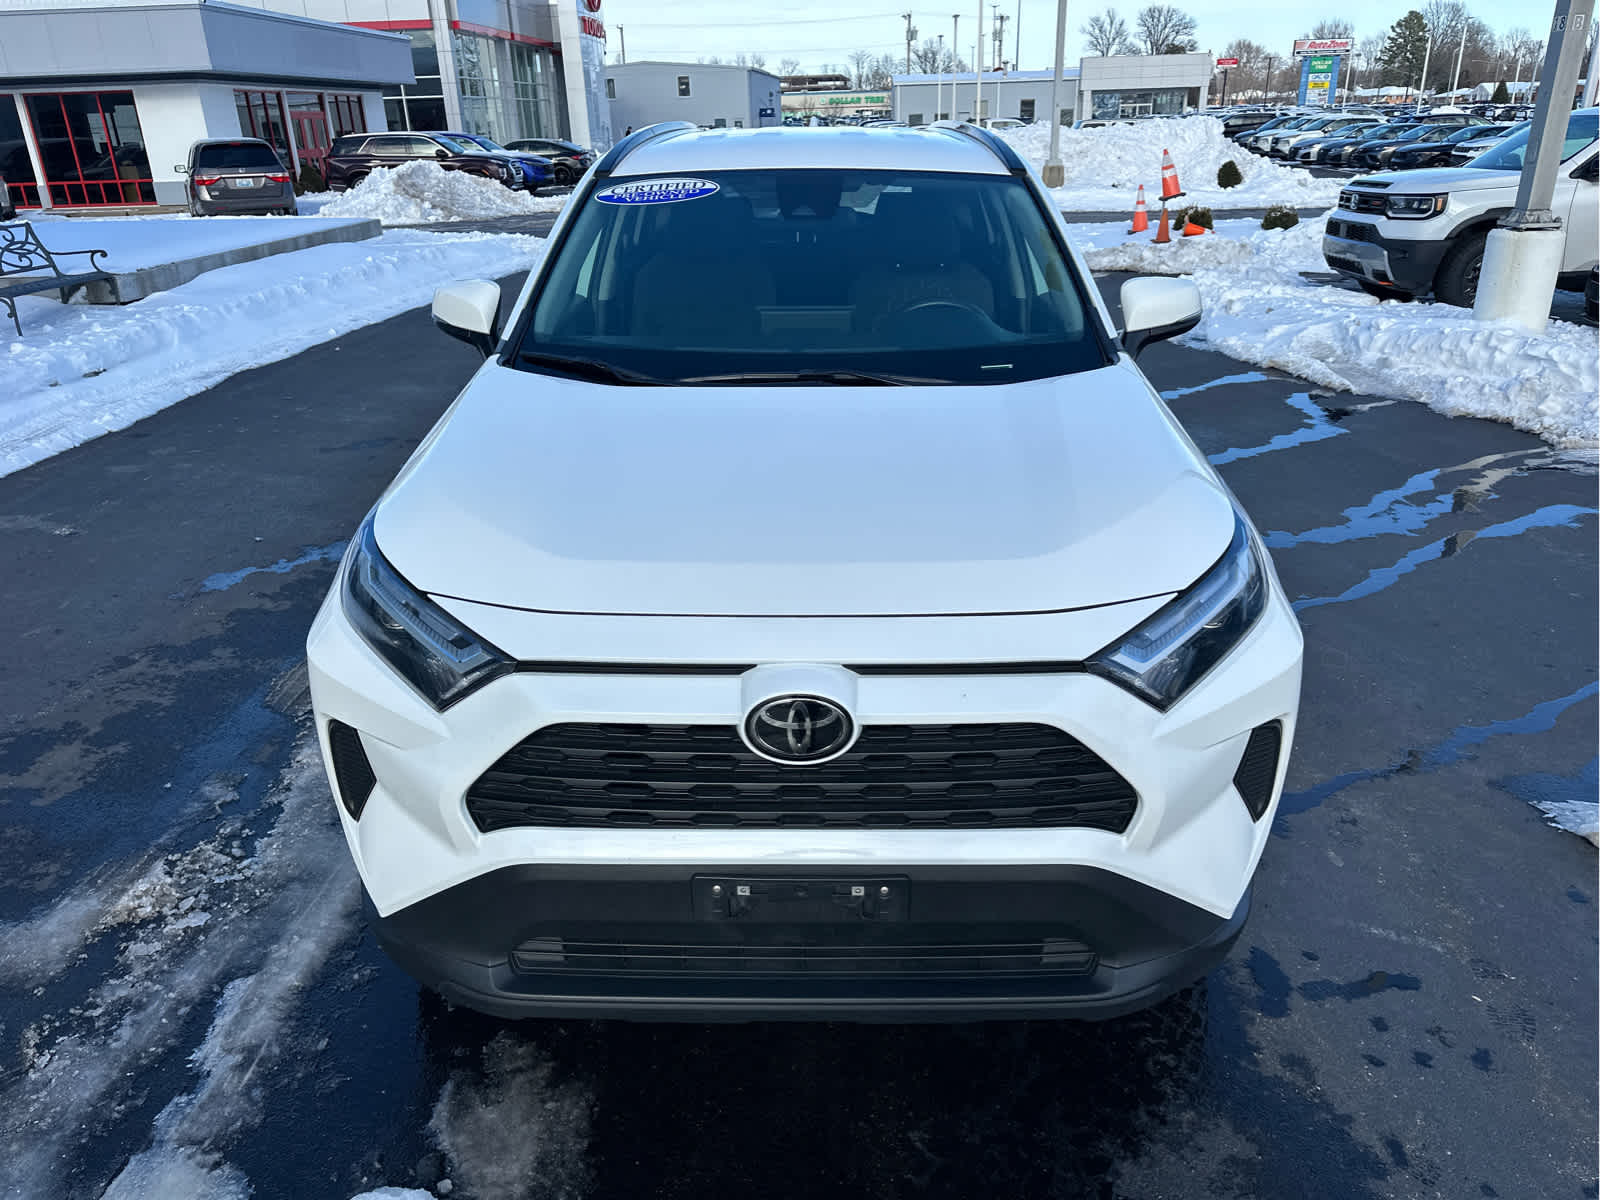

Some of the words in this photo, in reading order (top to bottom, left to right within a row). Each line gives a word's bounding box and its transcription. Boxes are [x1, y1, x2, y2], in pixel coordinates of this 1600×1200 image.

[829, 97, 862, 105] DOLLAR
[864, 95, 885, 104] TREE
[611, 181, 706, 194] CERTIFIED
[625, 192, 687, 203] VEHICLE
